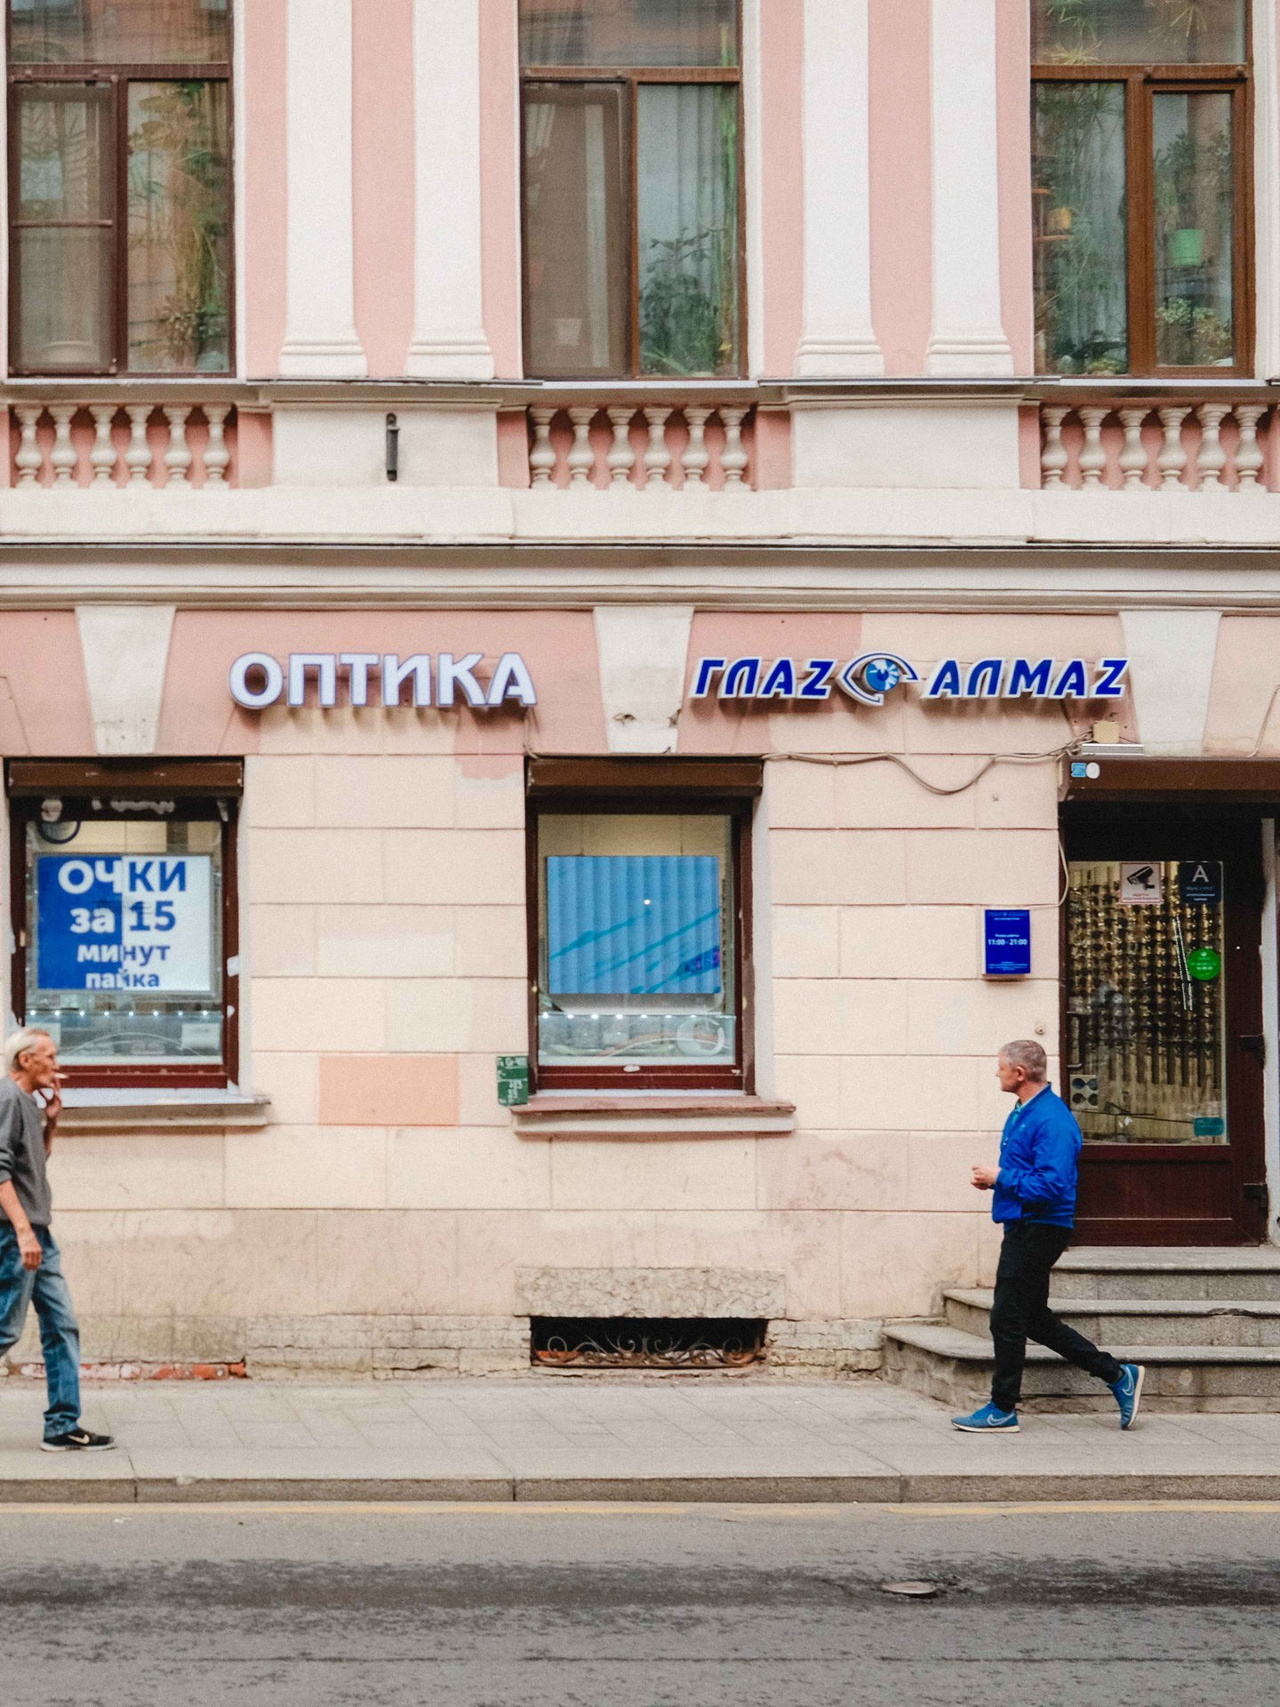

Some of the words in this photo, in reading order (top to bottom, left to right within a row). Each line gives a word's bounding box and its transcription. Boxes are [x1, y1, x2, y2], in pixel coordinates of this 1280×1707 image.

[228, 651, 538, 709] ОПТИКА
[70, 906, 117, 934] за
[128, 900, 177, 932] 15
[77, 944, 171, 968] минут
[85, 968, 161, 989] пайка
